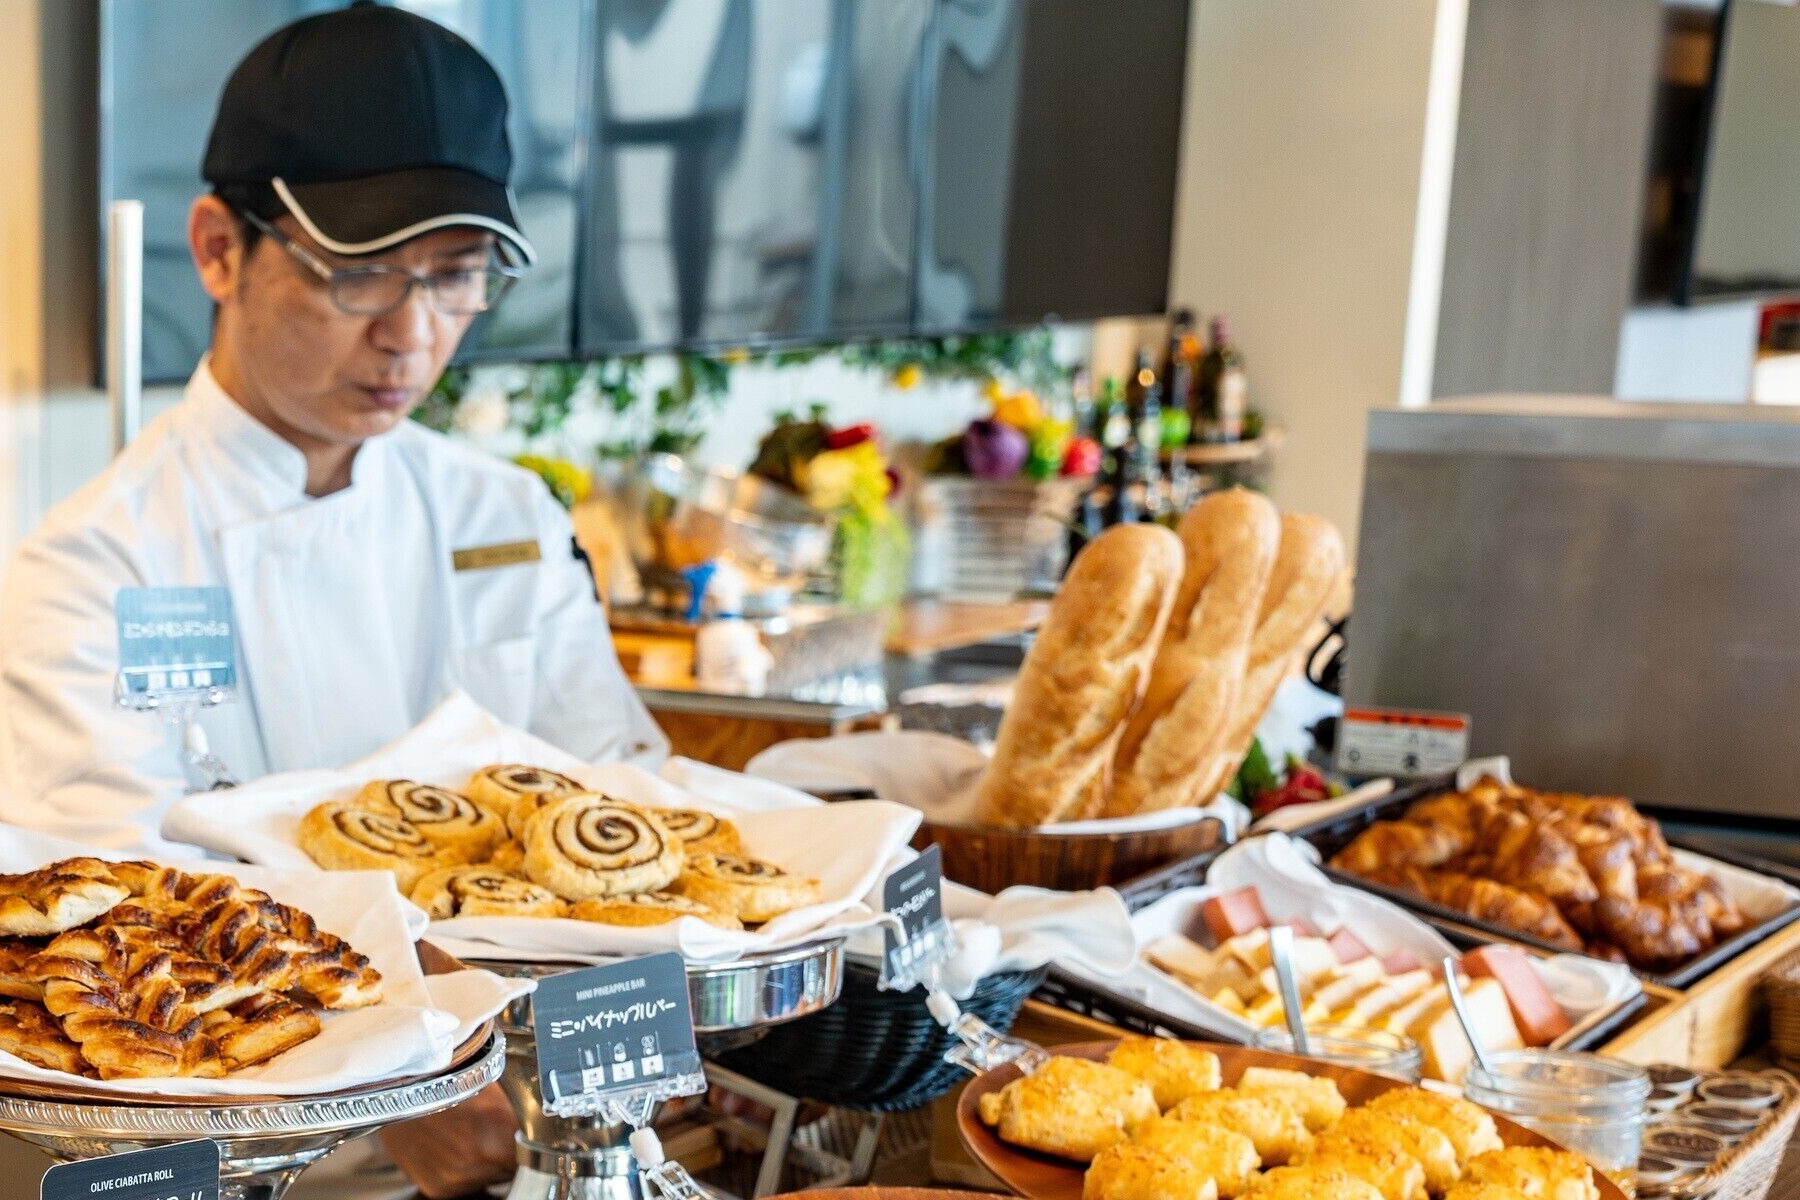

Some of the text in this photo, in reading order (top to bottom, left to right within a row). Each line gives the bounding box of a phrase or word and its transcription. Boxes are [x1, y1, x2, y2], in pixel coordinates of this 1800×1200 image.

[90, 1168, 174, 1193] OLIVE CIABATTA ROLL
